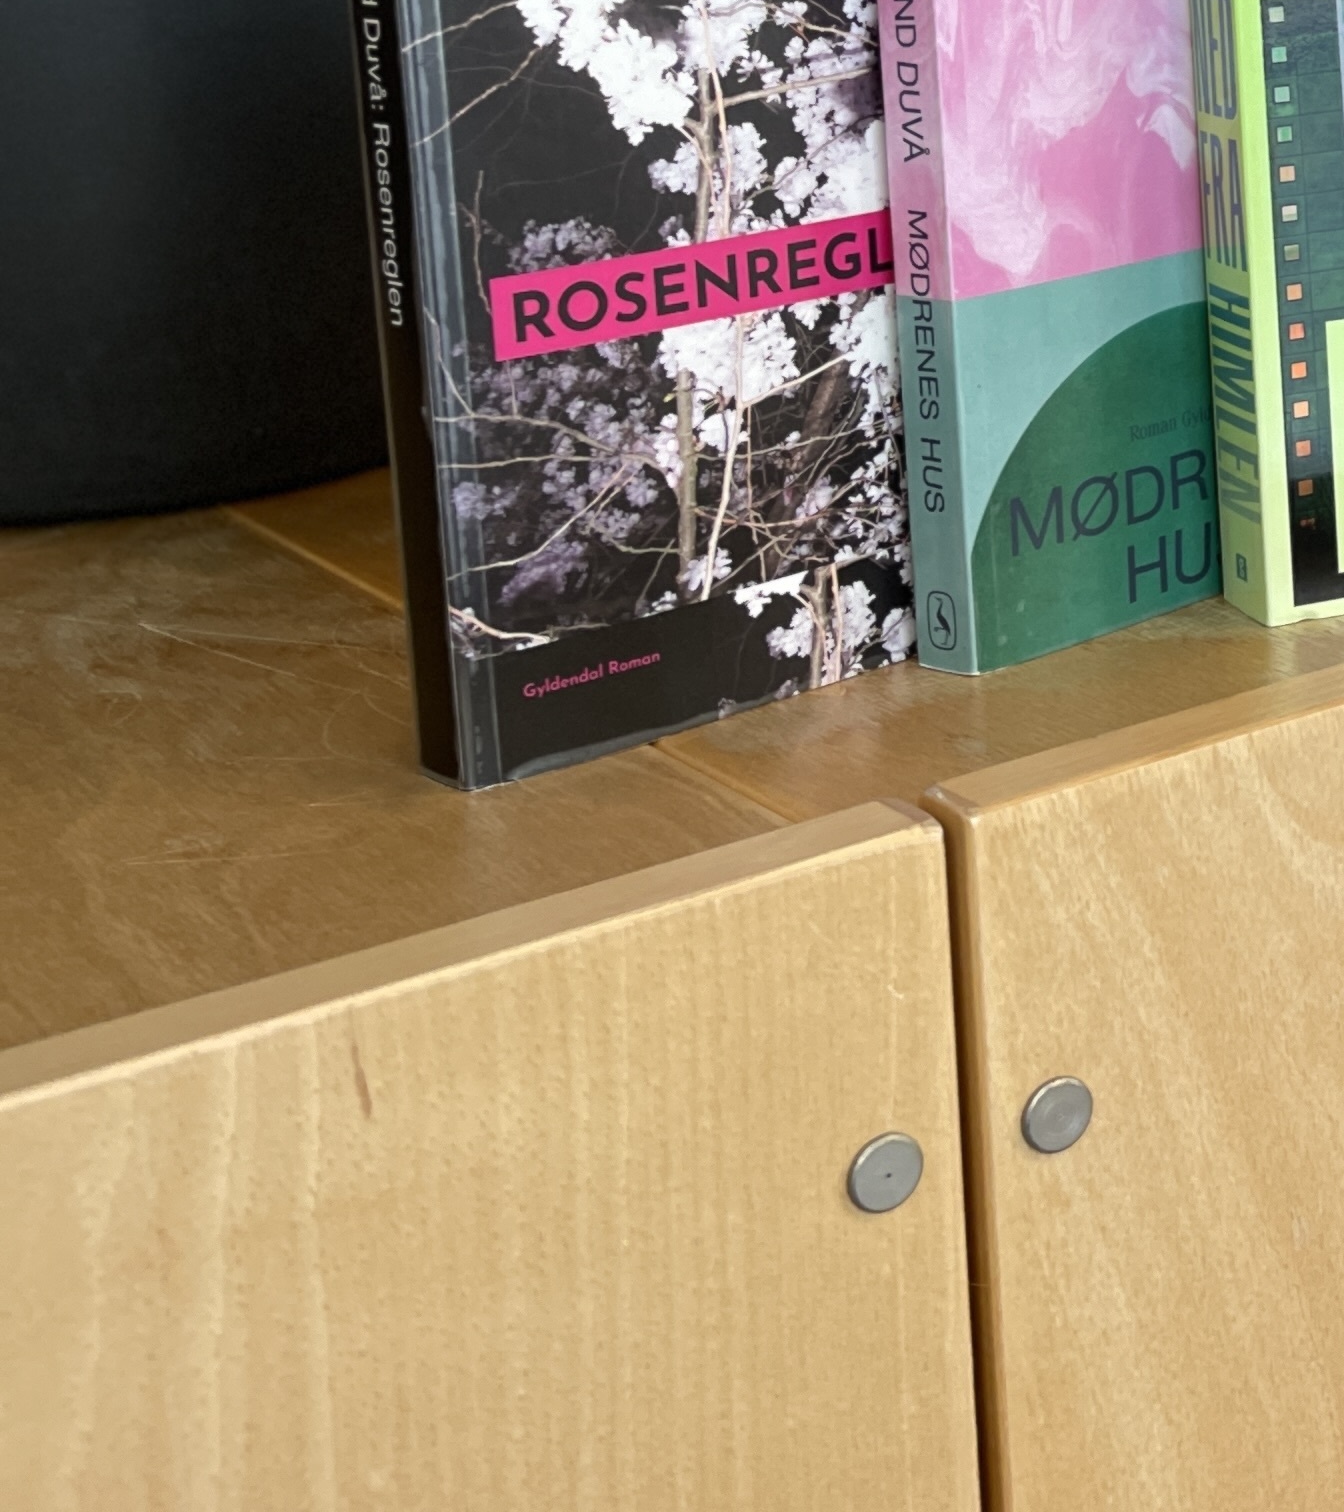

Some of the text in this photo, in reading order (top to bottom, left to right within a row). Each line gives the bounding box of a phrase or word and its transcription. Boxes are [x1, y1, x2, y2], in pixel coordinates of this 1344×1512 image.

[363, 18, 388, 111] Duvå:
[896, 61, 931, 163] DUVÅ
[372, 122, 404, 327] Rosenreglen
[1200, 130, 1248, 272] FRA
[512, 227, 894, 343] ROSENREGL
[907, 209, 939, 420] MØDRENES
[1129, 417, 1177, 442] Roman
[1208, 283, 1261, 525] HIMLEN
[919, 438, 945, 513] HUS
[1009, 448, 1209, 557] MØDR
[1127, 522, 1221, 604] HU
[522, 652, 661, 698] Gyldendal Roman
